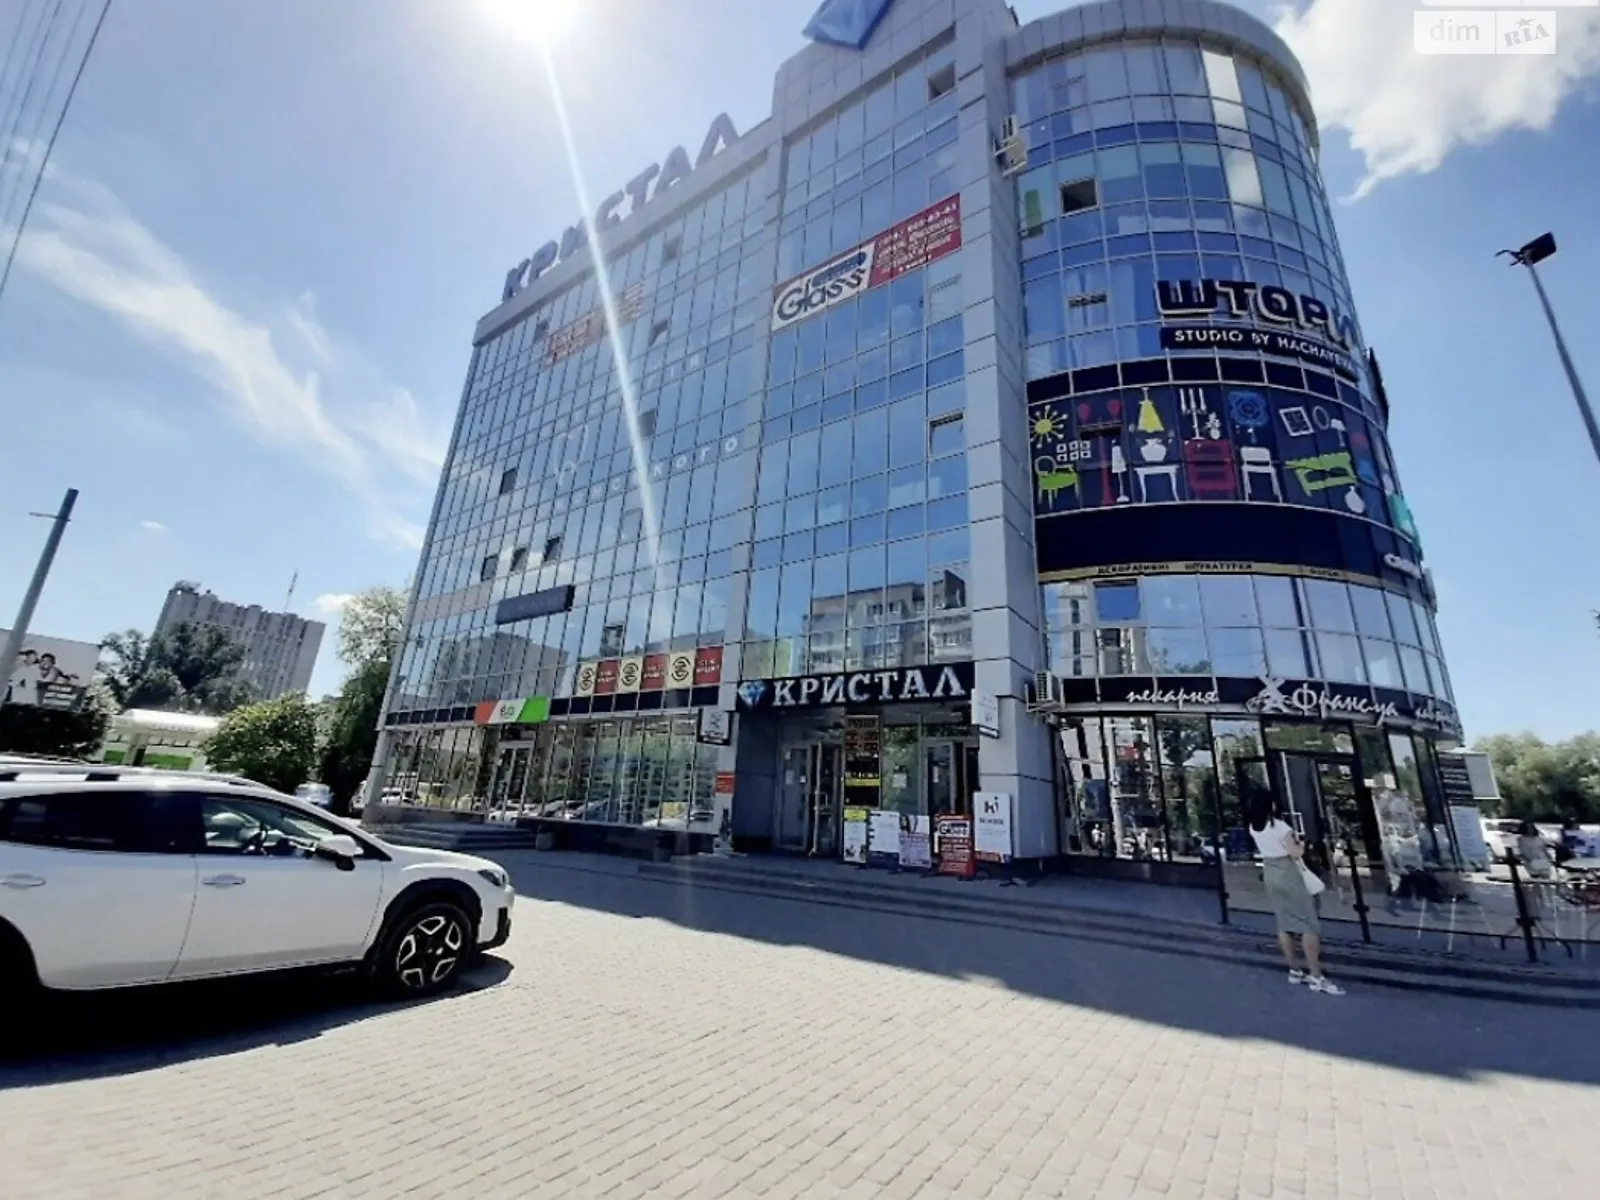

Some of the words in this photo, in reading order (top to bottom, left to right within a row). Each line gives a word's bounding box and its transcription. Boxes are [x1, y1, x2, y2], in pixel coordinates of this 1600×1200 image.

[777, 267, 867, 321] Glass
[1155, 279, 1354, 349] ШТОРИ
[1174, 329, 1244, 342] STUDIO
[1251, 332, 1270, 345] BY
[772, 666, 966, 707] КРИСТАЛ
[1126, 687, 1220, 710] пекарня
